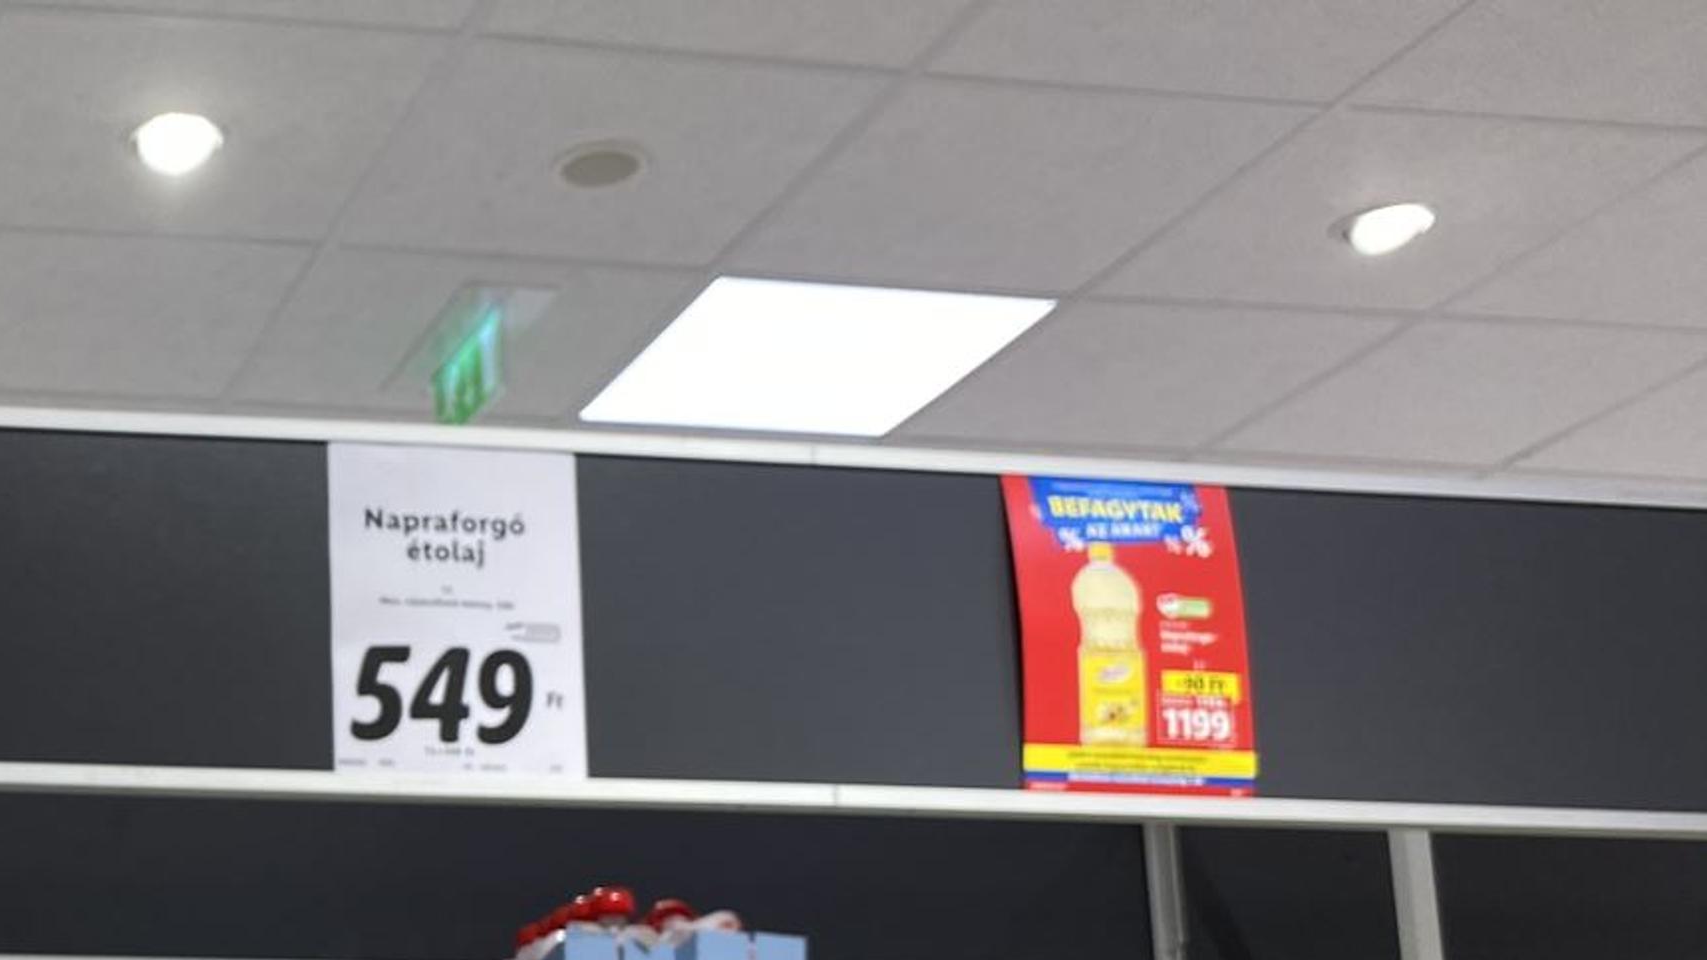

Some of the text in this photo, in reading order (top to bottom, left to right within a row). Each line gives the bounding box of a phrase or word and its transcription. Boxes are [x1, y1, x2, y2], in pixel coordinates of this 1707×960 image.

[364, 508, 525, 540] Napraforgó
[1048, 494, 1183, 523] BEFAGYTAK
[407, 541, 485, 569] étolaj
[350, 644, 533, 745] 549
[1162, 708, 1230, 741] 1199
